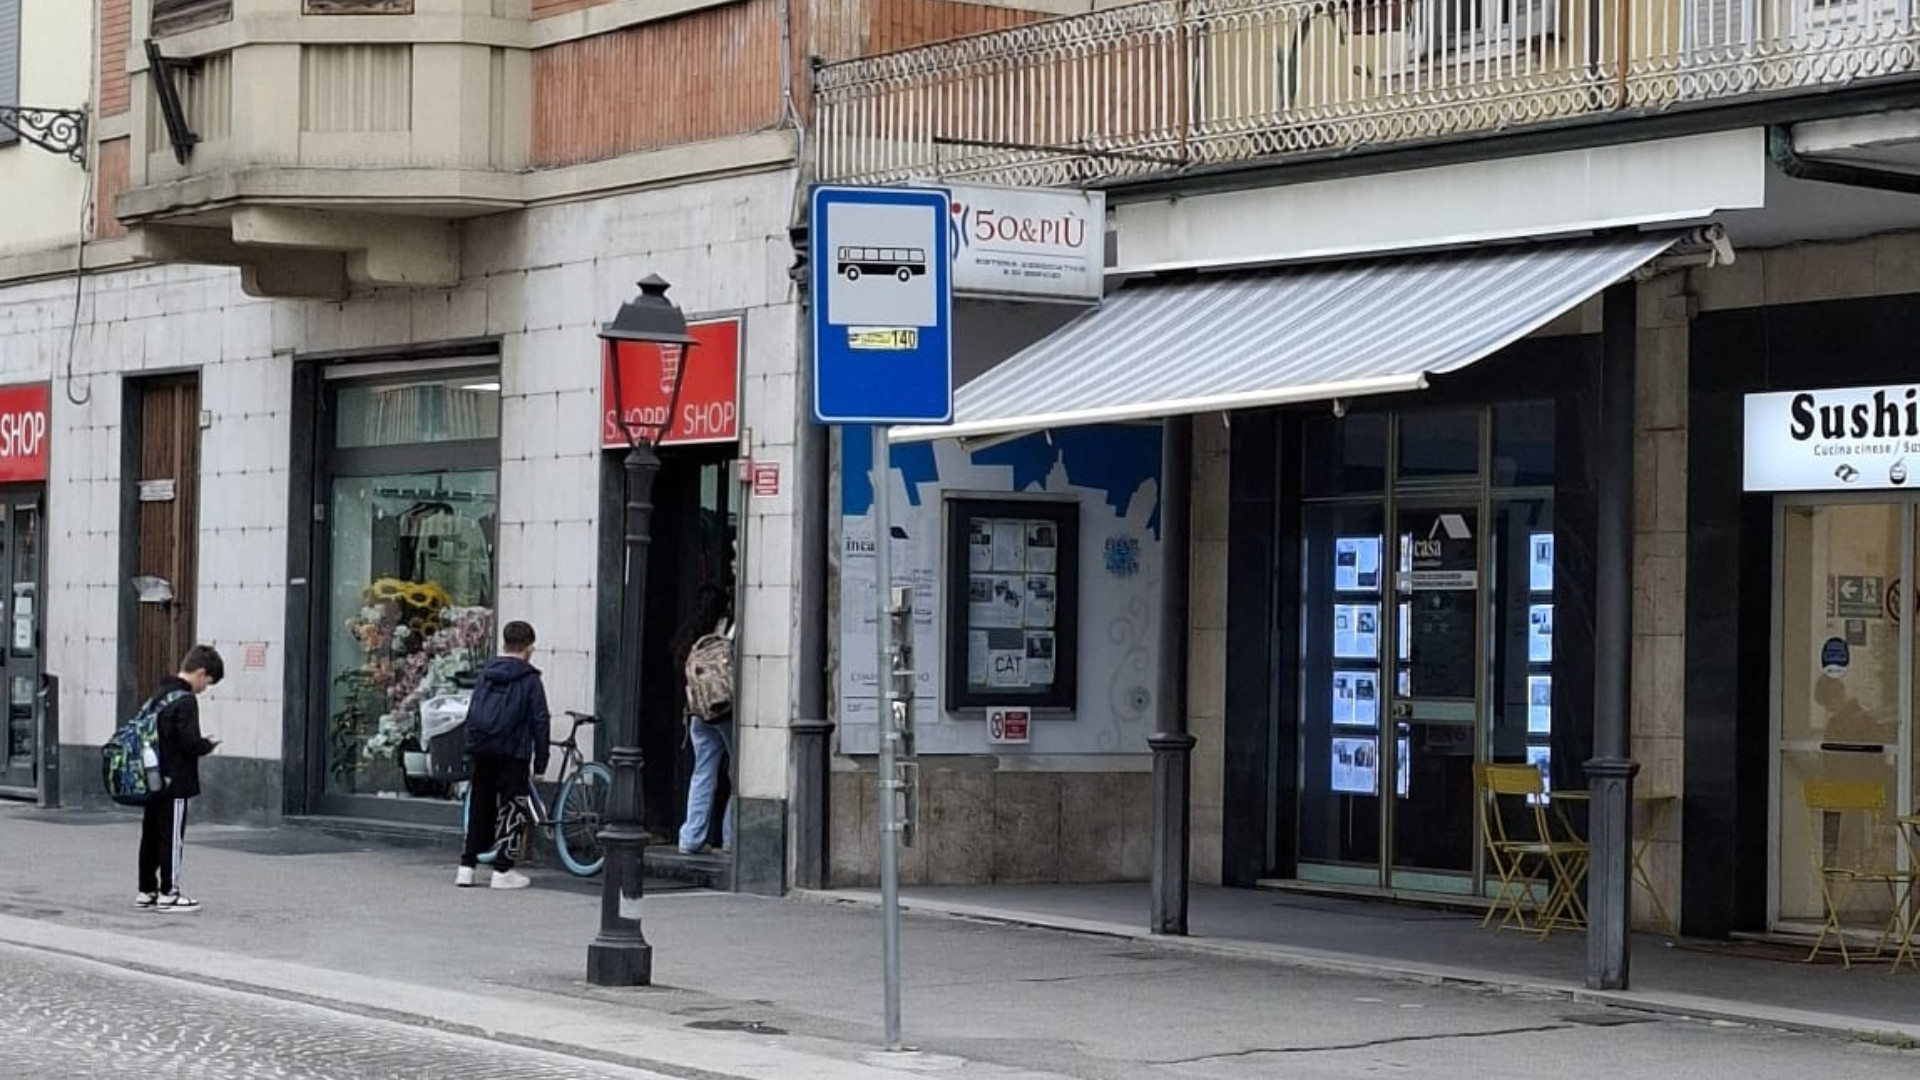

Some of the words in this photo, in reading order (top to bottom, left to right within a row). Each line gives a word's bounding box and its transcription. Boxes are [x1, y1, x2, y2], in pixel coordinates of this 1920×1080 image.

[975, 209, 1085, 248] 50&PIÙ
[892, 330, 916, 347] 140
[683, 402, 735, 435] SHOP
[1790, 388, 1919, 441] Sushi
[0, 411, 46, 457] SHOP
[1813, 444, 1852, 456] Cucina
[1854, 443, 1891, 455] cinese
[995, 653, 1024, 675] CAT
